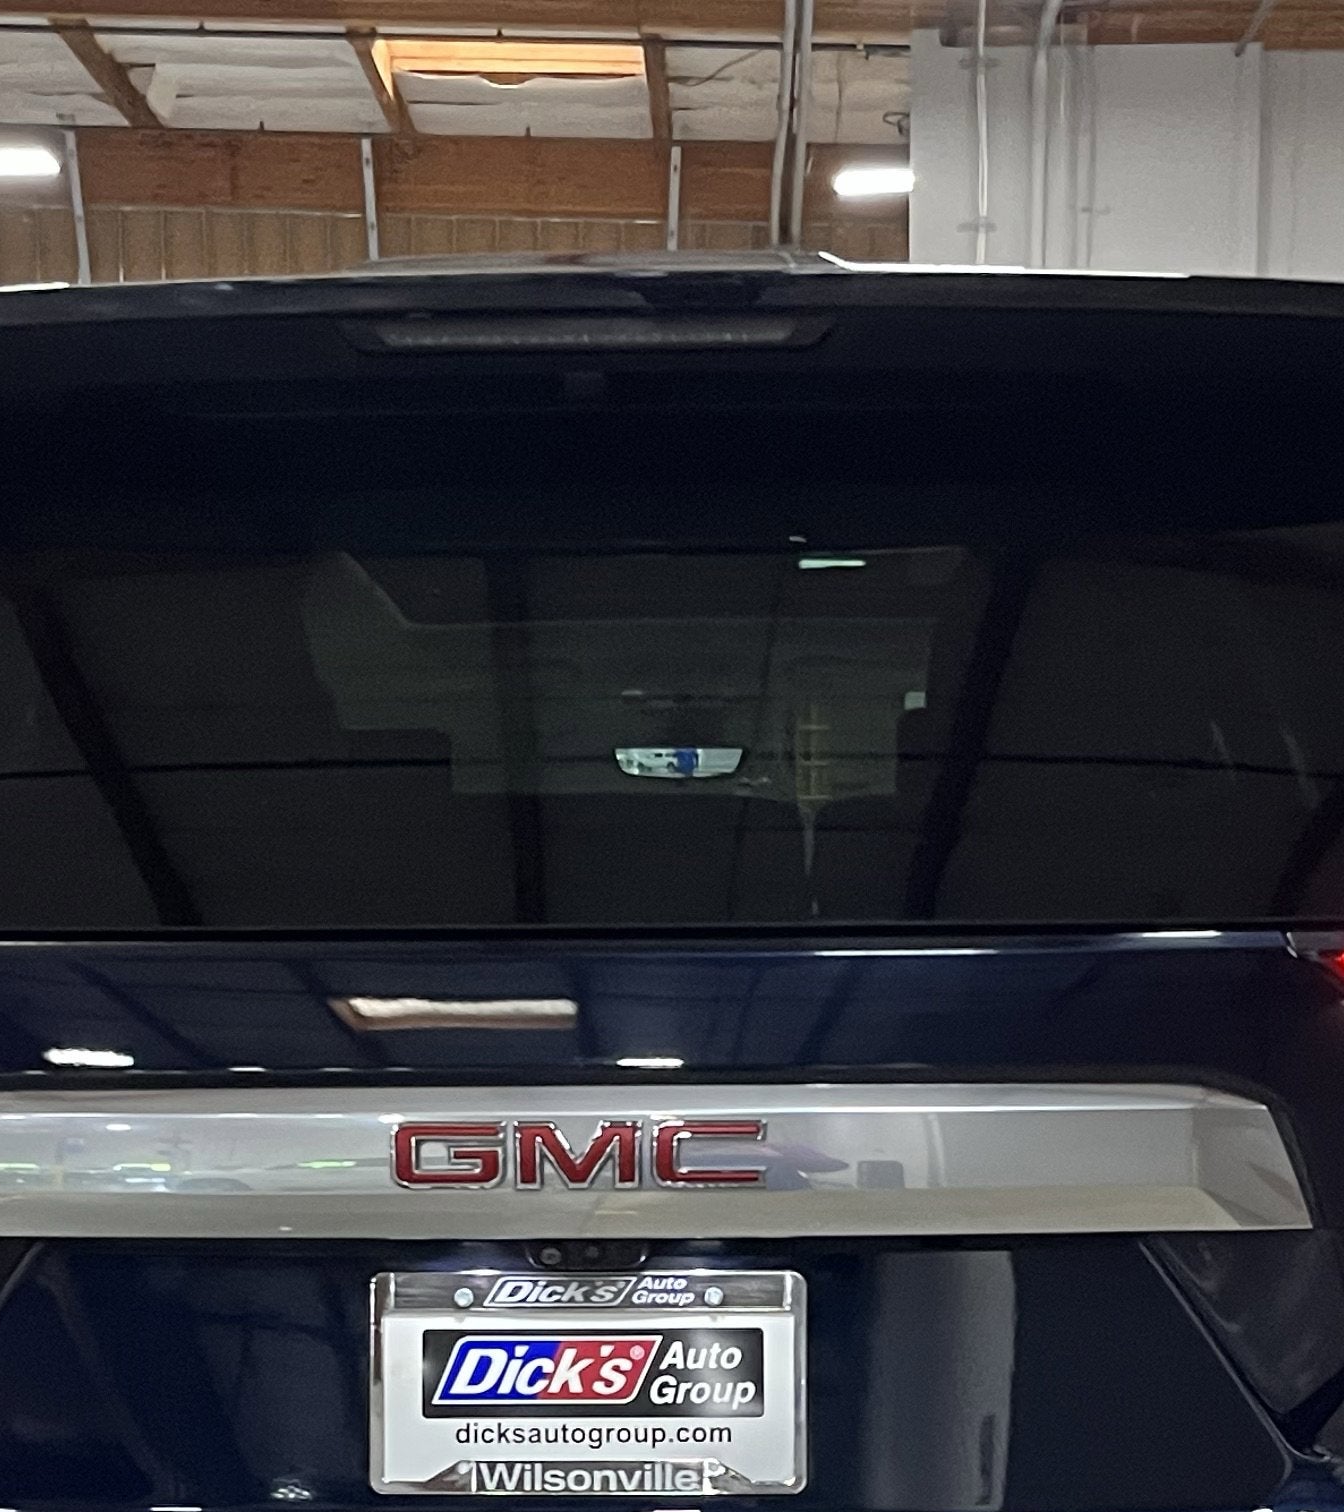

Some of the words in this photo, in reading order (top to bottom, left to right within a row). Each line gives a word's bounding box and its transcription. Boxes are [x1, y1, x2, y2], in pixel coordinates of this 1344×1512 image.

[391, 1119, 768, 1190] GMC
[631, 1290, 696, 1307] Group
[637, 1276, 689, 1291] Auto
[449, 1344, 633, 1395] Dick's
[660, 1341, 743, 1370] Auto
[649, 1376, 757, 1410] Group
[455, 1422, 733, 1449] dicksautogroup.com
[480, 1461, 700, 1492] Wilsonville
